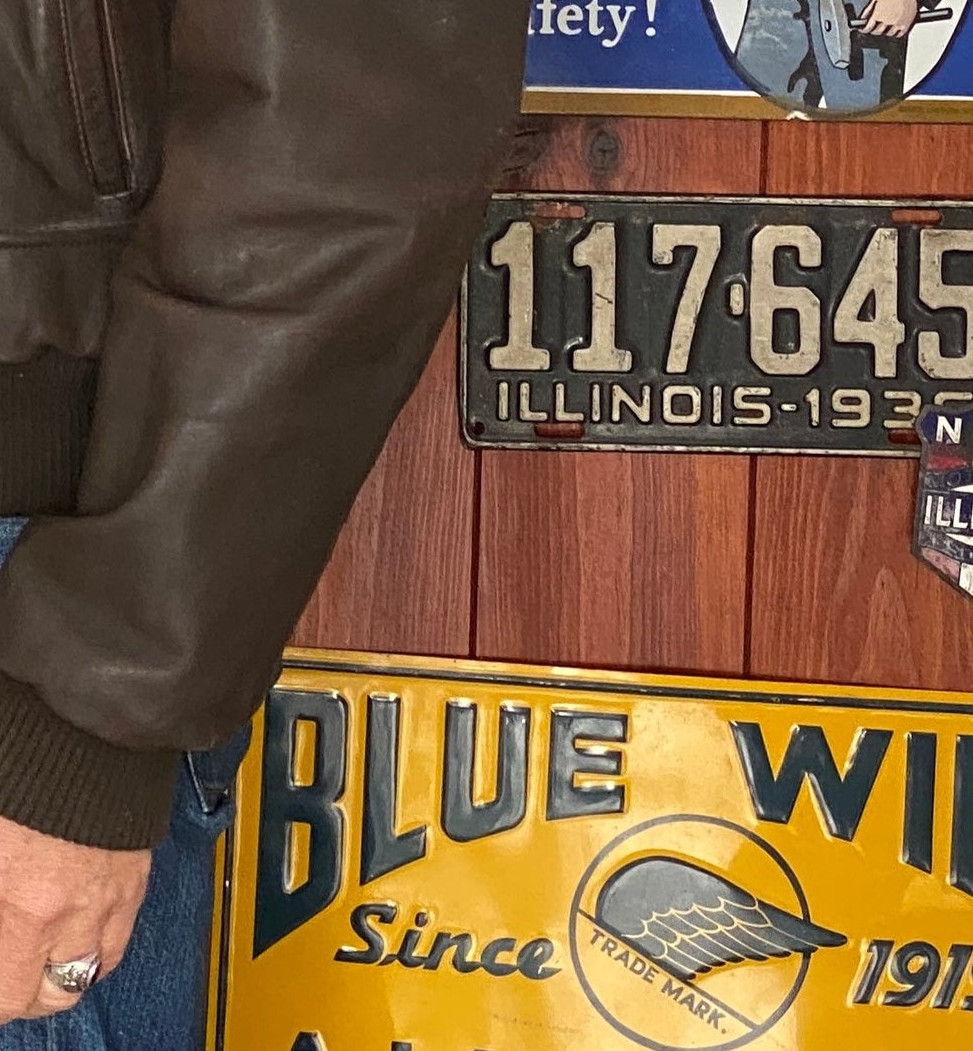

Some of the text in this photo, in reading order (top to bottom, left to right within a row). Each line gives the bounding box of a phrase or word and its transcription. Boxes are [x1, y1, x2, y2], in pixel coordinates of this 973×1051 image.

[496, 382, 973, 429] ILLINOIS-193
[924, 494, 973, 530] ILL
[253, 688, 629, 960] BLUE
[334, 903, 563, 981] Since
[589, 928, 660, 985] TRADE
